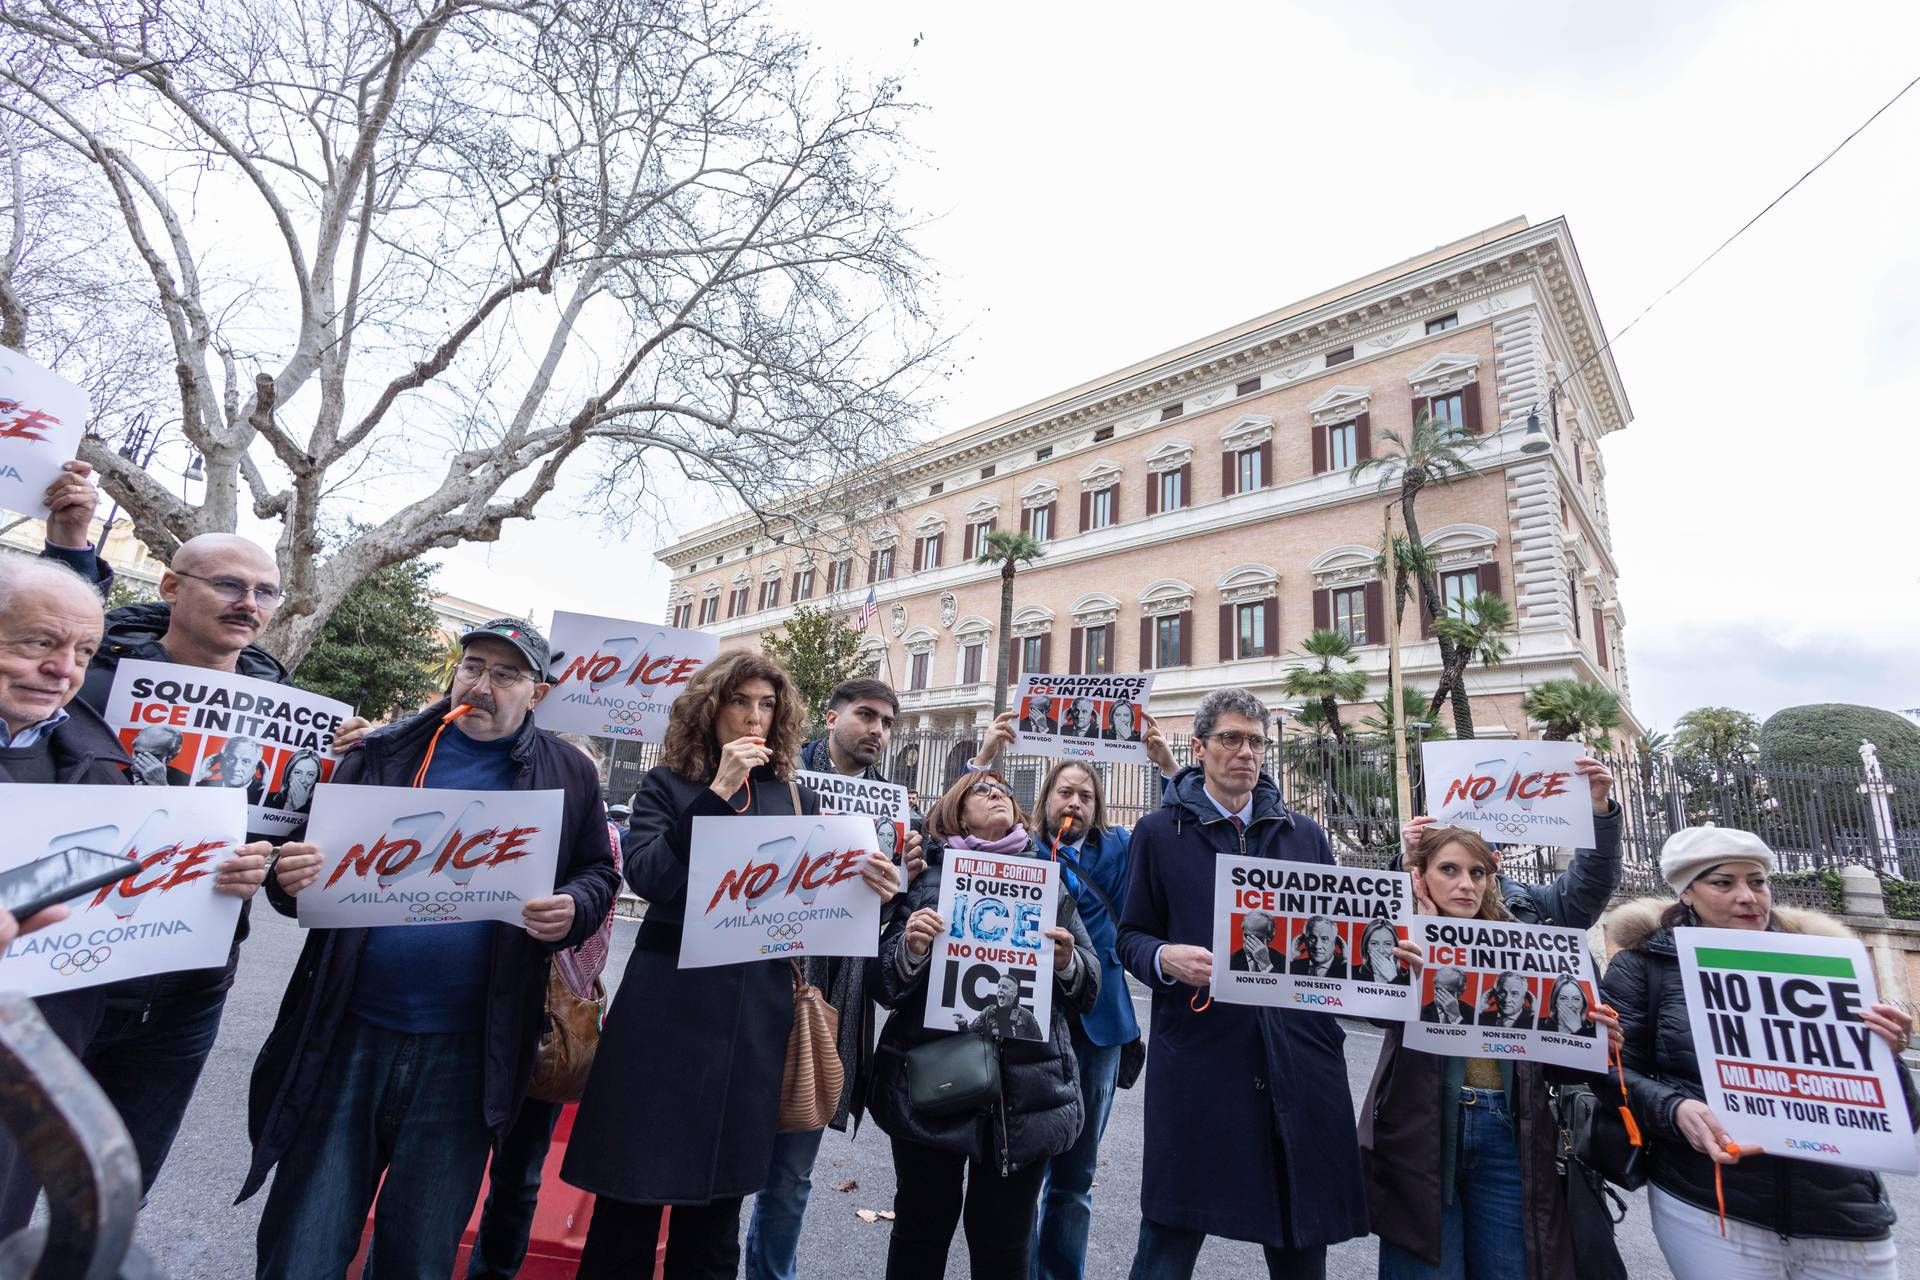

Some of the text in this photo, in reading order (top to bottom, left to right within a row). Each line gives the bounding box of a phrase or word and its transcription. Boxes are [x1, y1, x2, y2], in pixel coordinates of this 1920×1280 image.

[556, 650, 704, 688] NO ICE
[1028, 677, 1147, 688] SQUADRACCE
[131, 678, 343, 734] SQUADRACCE
[562, 692, 671, 714] MILANO CORTI
[1028, 686, 1140, 700] ICE IN ITALIA?
[129, 702, 334, 753] ICE IN ITALIA?
[1442, 769, 1572, 808] NO ICE
[263, 813, 281, 822] NON
[281, 816, 303, 825] PARLO
[838, 796, 900, 818] ITALIA?
[1452, 811, 1570, 826] MILANO CORTINA
[323, 825, 541, 891] NO ICE
[957, 858, 996, 876] MILANO
[704, 846, 867, 917] NO ICE
[956, 874, 1042, 900] SÌ QUESTO
[1231, 867, 1403, 898] SQUADRACCE
[337, 890, 521, 904] MILANO CORTINA
[1235, 889, 1401, 920] ICE IN ITALIA?
[714, 907, 853, 929] MILANO CORTINA
[949, 893, 1042, 950] ICE
[6, 919, 192, 958] LANO CORTINA
[1425, 924, 1580, 954] SQUADRACCE
[947, 943, 1038, 966] NO QUESTA
[1429, 945, 1580, 975] ICE IN ITALIA?
[941, 959, 1036, 1013] ICE
[1236, 976, 1277, 985] NON VEDO
[1294, 980, 1342, 991] NON SENTO
[1357, 986, 1378, 995] NON
[1379, 988, 1406, 998] PARLO
[1698, 971, 1866, 1023] NO ICE
[1426, 1027, 1467, 1036] NON VEDO
[1482, 1031, 1527, 1041] NON SENTO
[1541, 1035, 1561, 1045] NON
[1562, 1038, 1592, 1049] PARLO
[1707, 1013, 1873, 1071] IN ITALY
[1721, 1064, 1879, 1104] MILANO-CORTINA
[1723, 1093, 1892, 1132] IS NOT YOUR GAME
